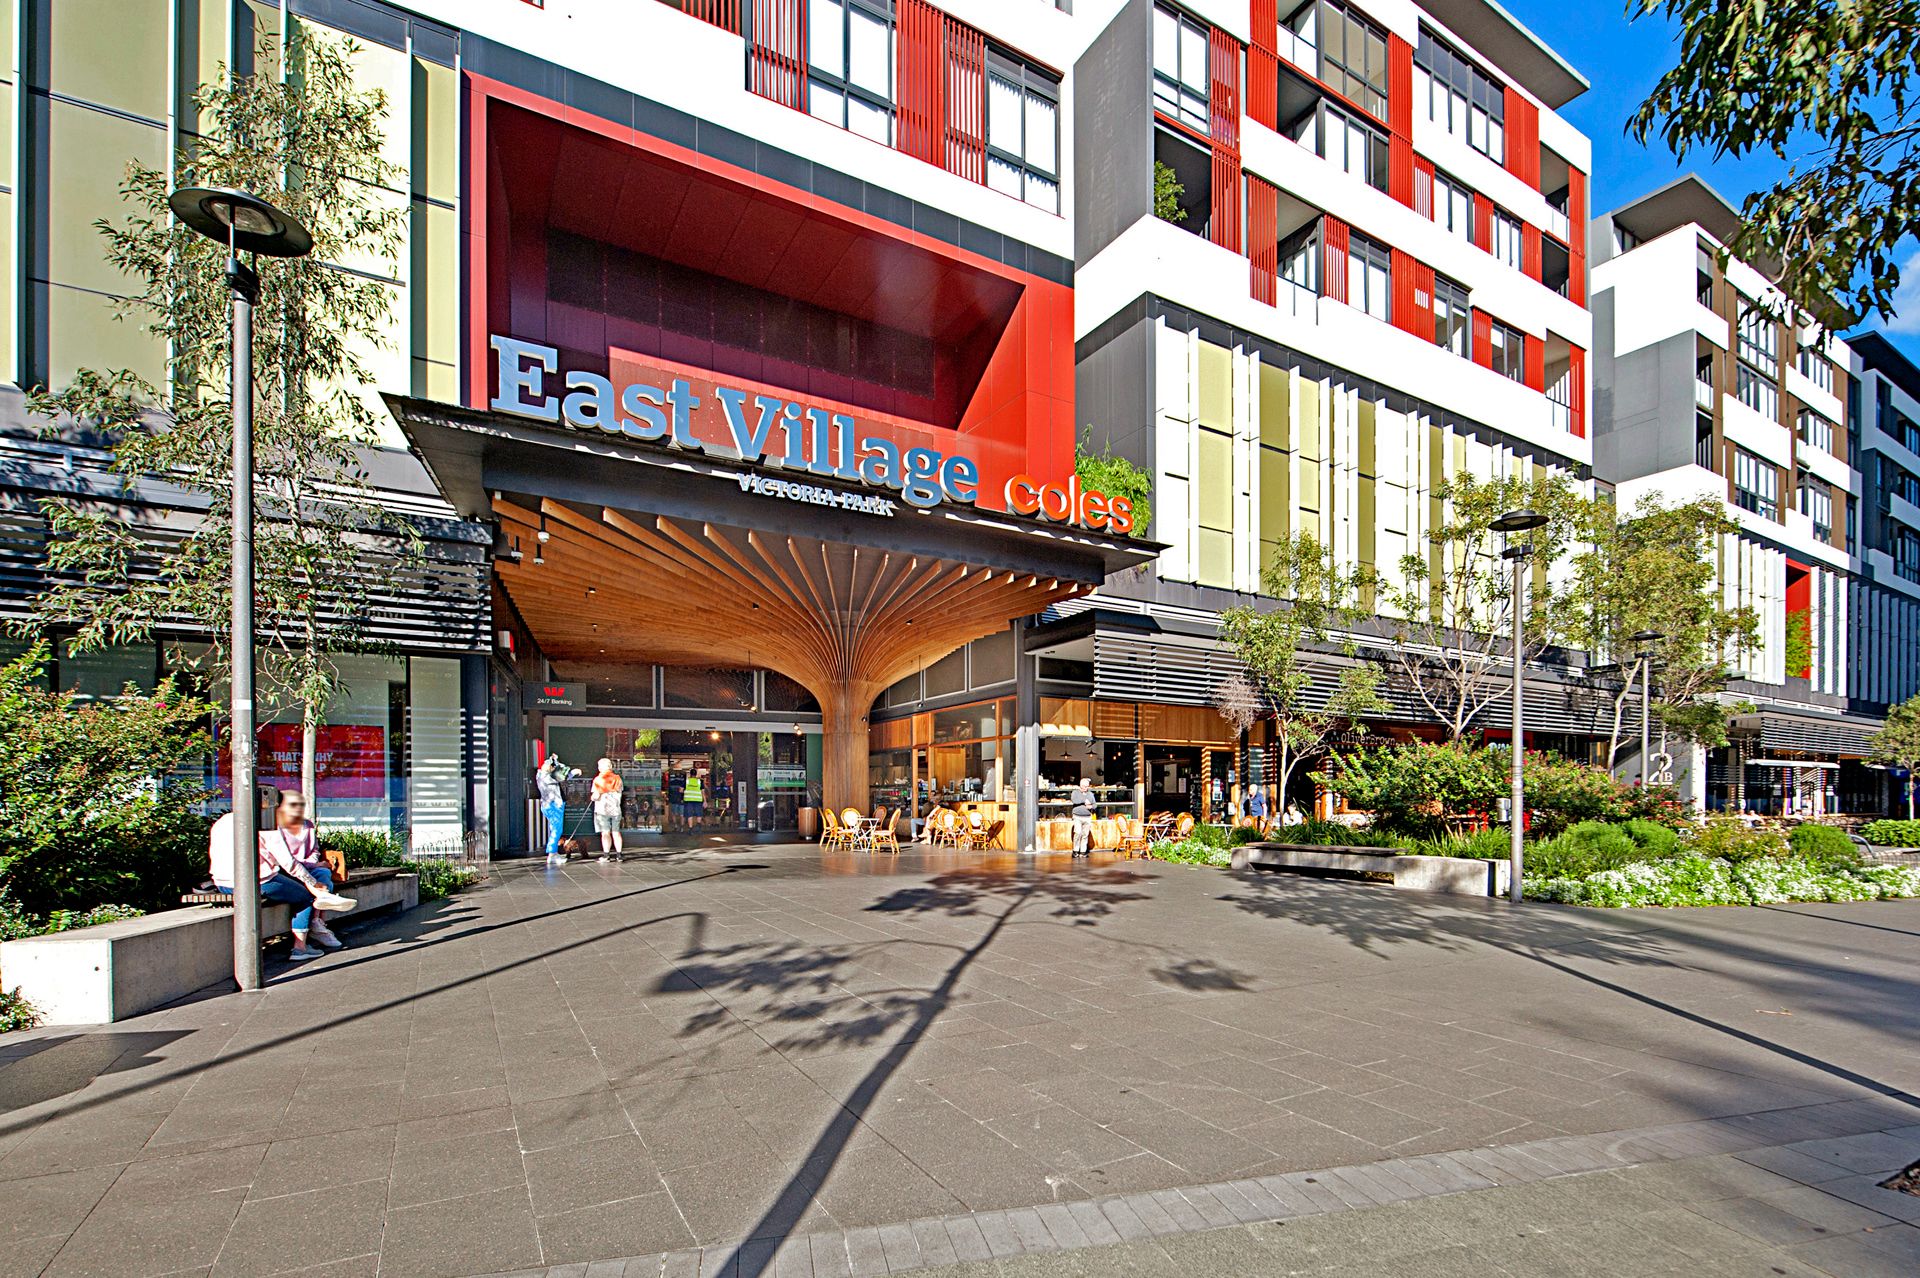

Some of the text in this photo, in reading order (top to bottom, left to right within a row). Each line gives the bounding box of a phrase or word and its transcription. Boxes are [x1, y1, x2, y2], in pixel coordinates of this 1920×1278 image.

[490, 334, 979, 508] East Village
[736, 472, 894, 517] VICTORIA PARK
[1004, 473, 1134, 534] coles
[272, 752, 303, 761] THAT'
[282, 763, 298, 772] WE
